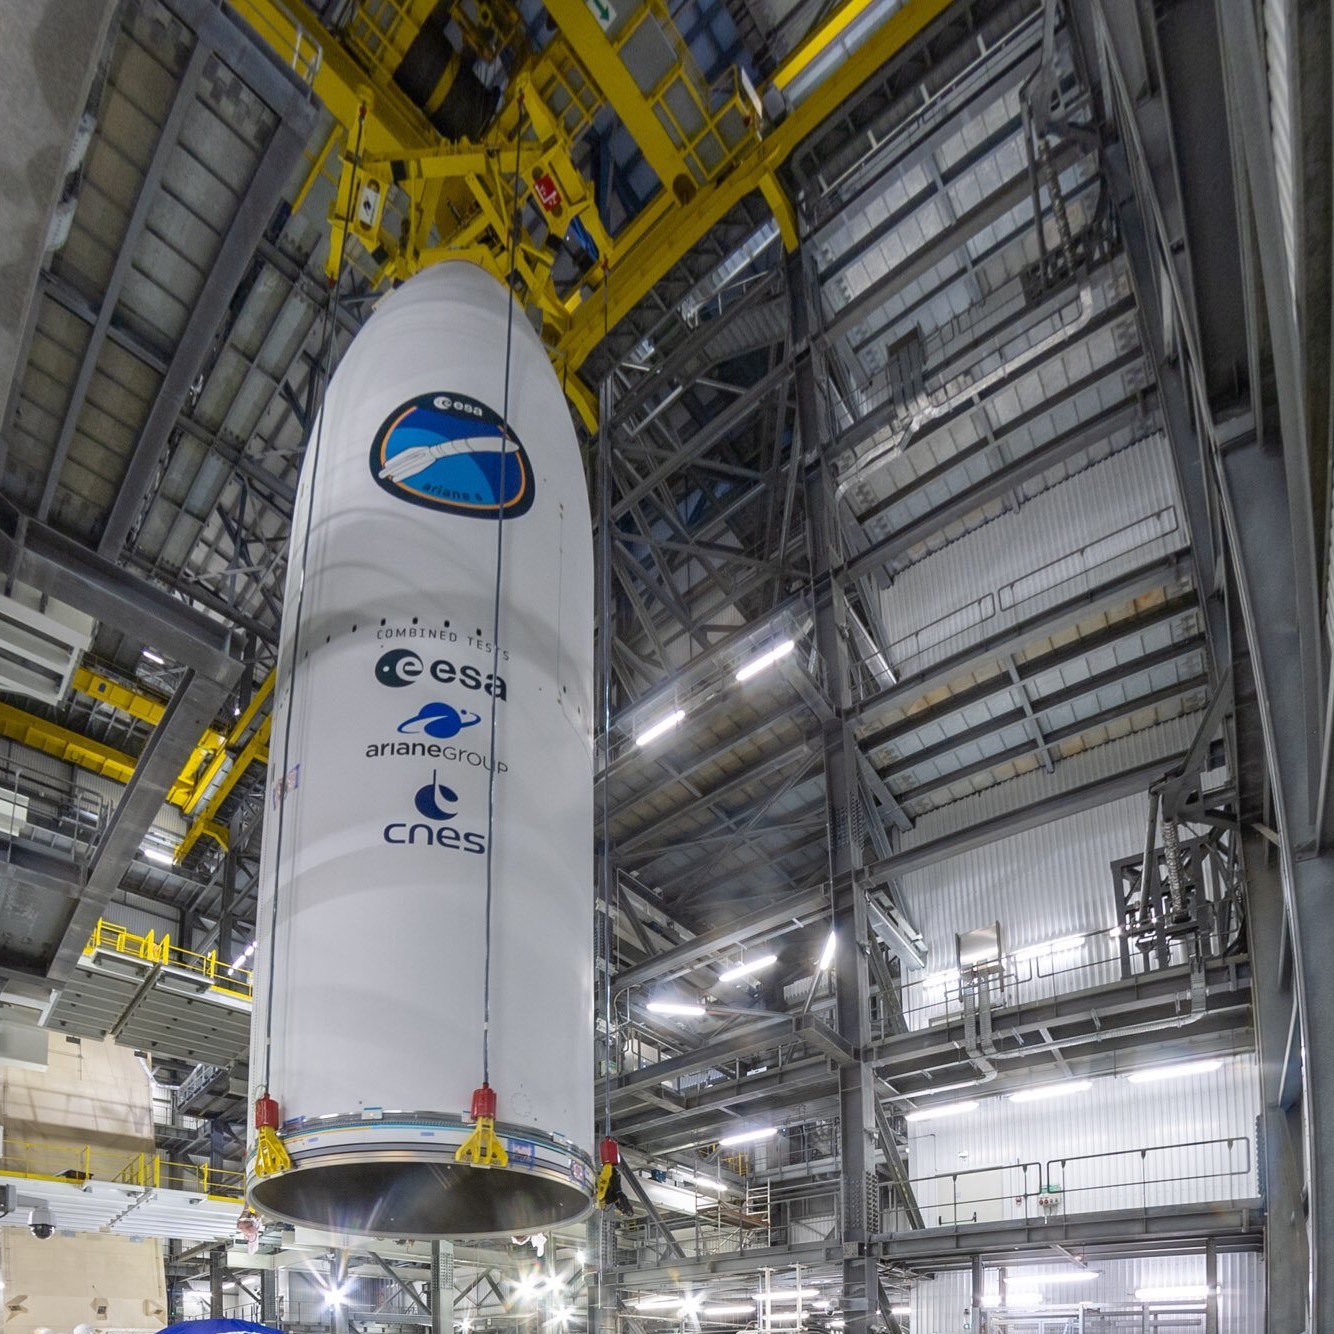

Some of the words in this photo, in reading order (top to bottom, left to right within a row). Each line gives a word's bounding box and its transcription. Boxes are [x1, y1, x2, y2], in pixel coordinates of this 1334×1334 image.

[453, 401, 483, 417] esa
[422, 482, 470, 500] ariane
[377, 627, 457, 643] COMBINED
[467, 636, 510, 661] TESS
[430, 660, 507, 702] esa
[383, 823, 486, 854] cnes
